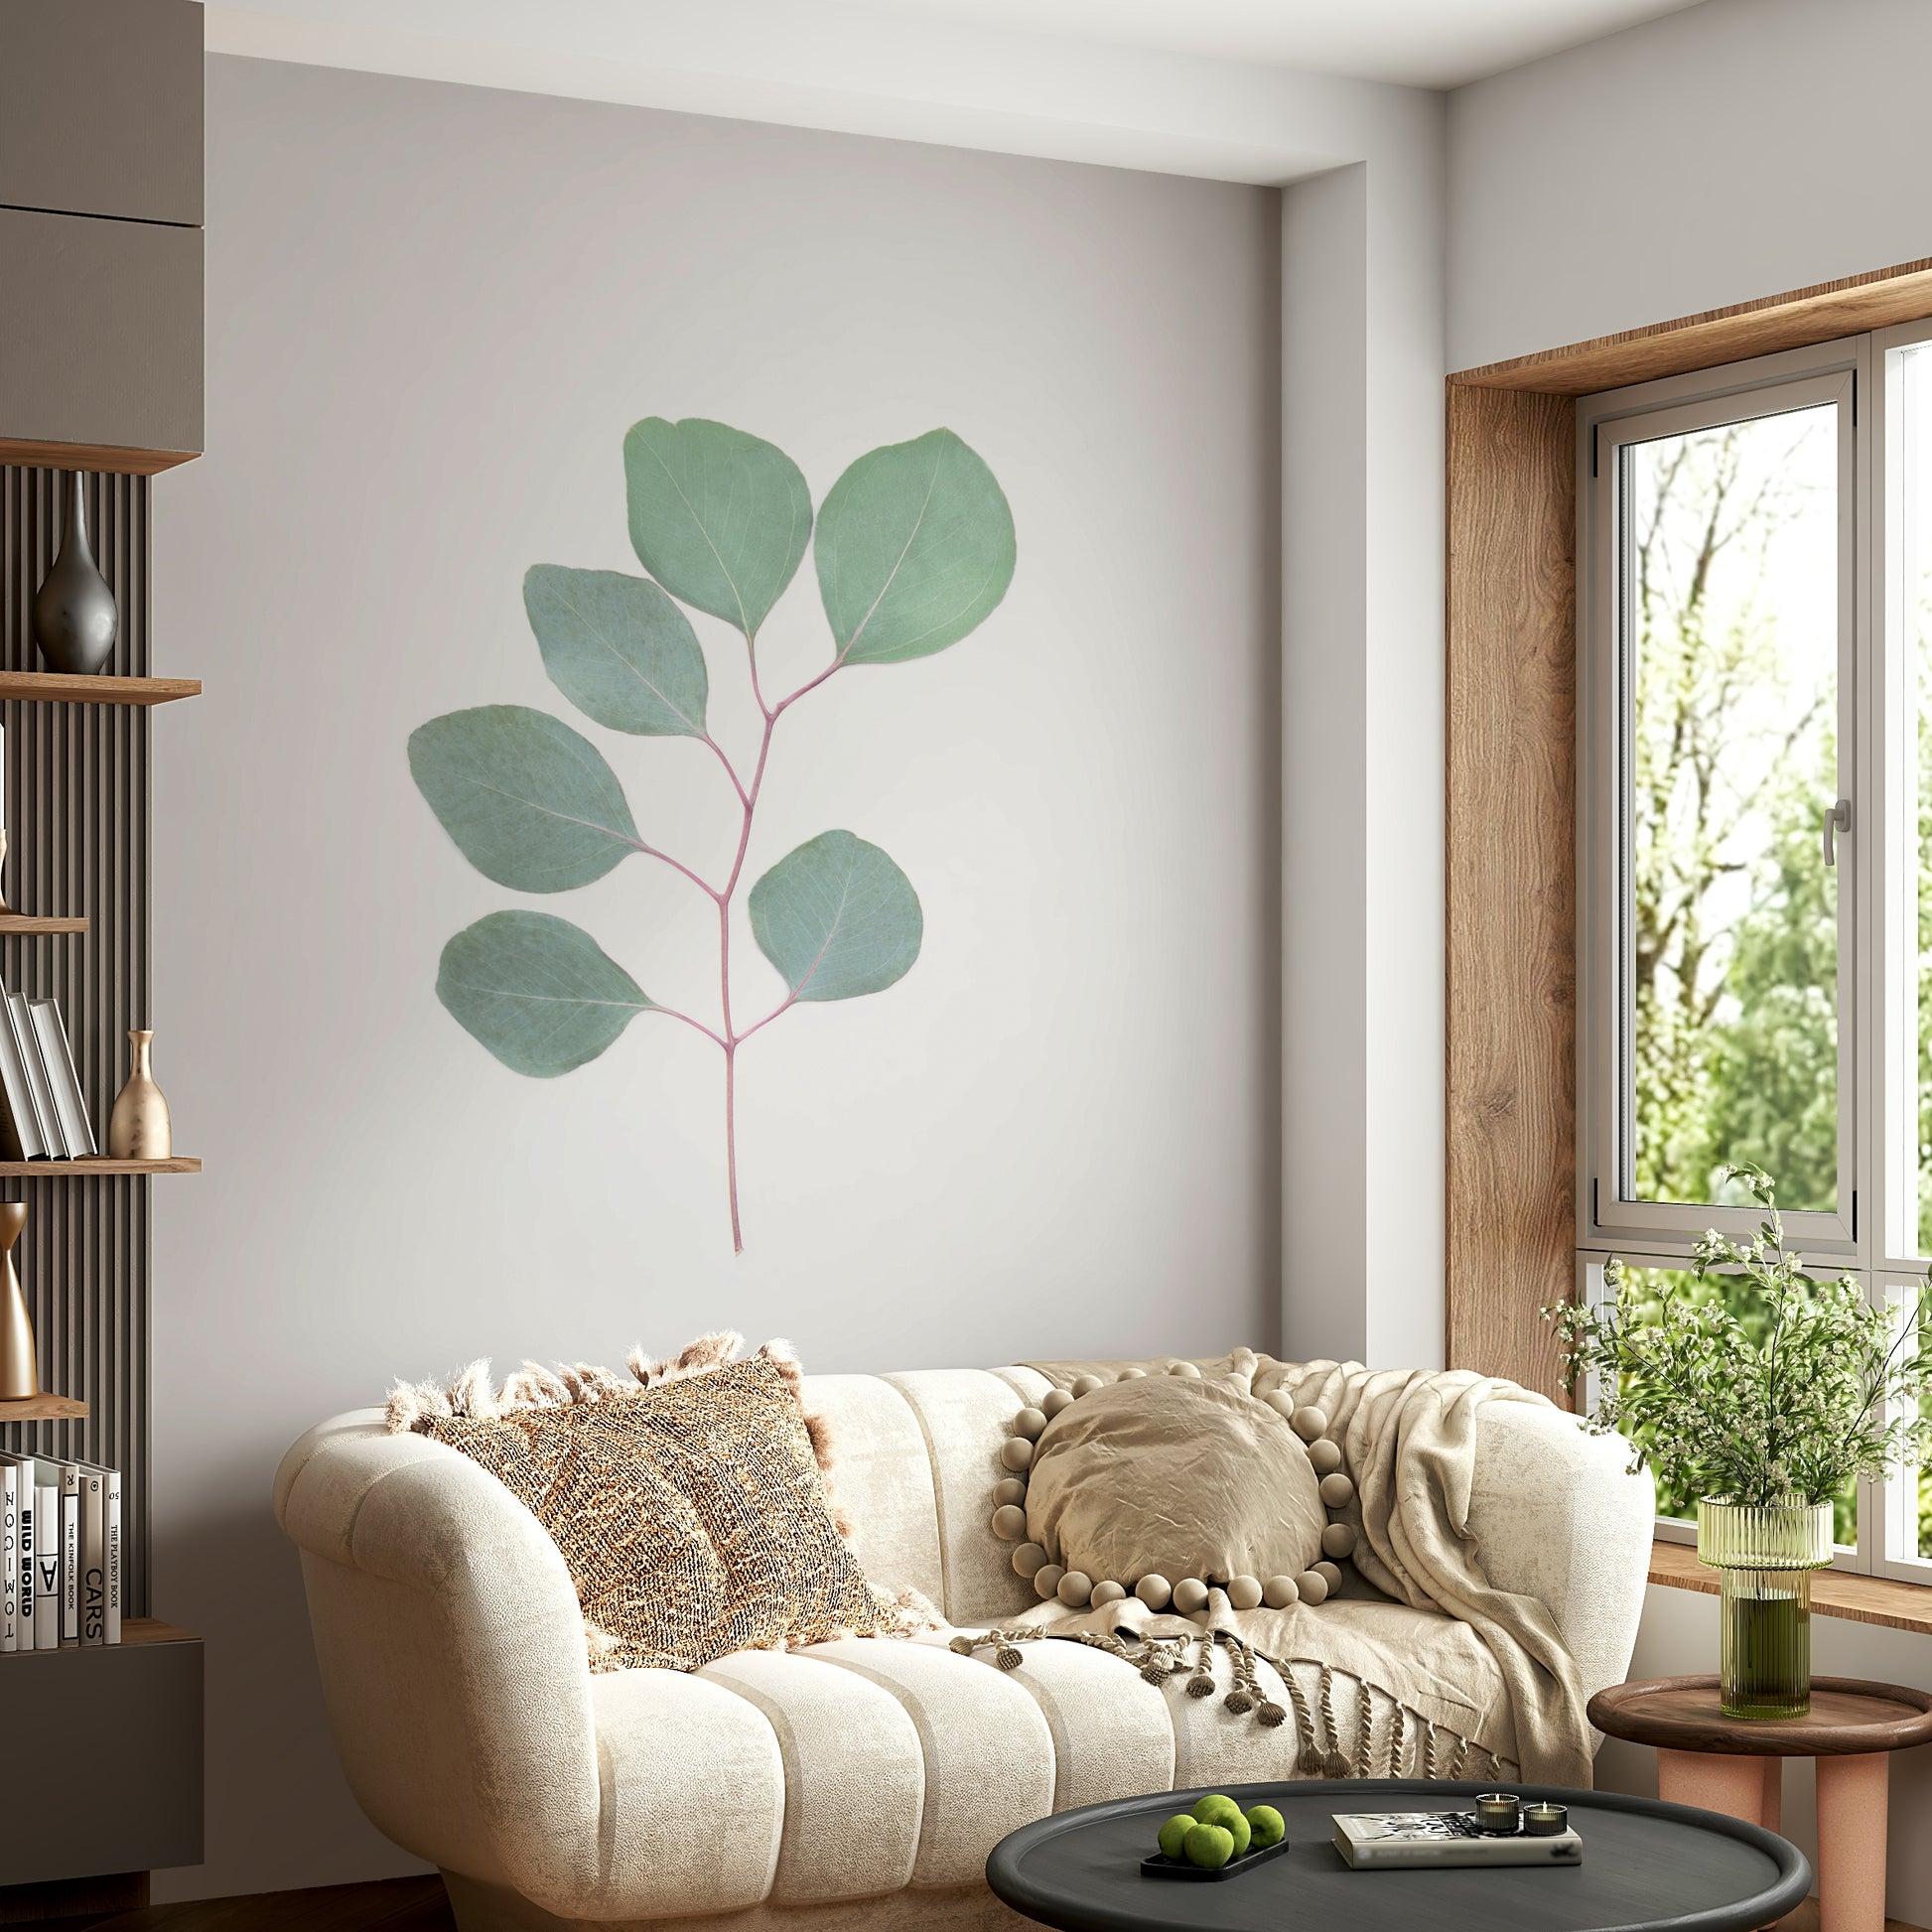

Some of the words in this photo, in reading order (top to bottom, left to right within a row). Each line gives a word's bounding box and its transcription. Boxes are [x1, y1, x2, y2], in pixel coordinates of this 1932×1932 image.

[22, 1510, 32, 1551] WILD
[22, 1558, 32, 1617] WORLD
[85, 1568, 102, 1639] CARS
